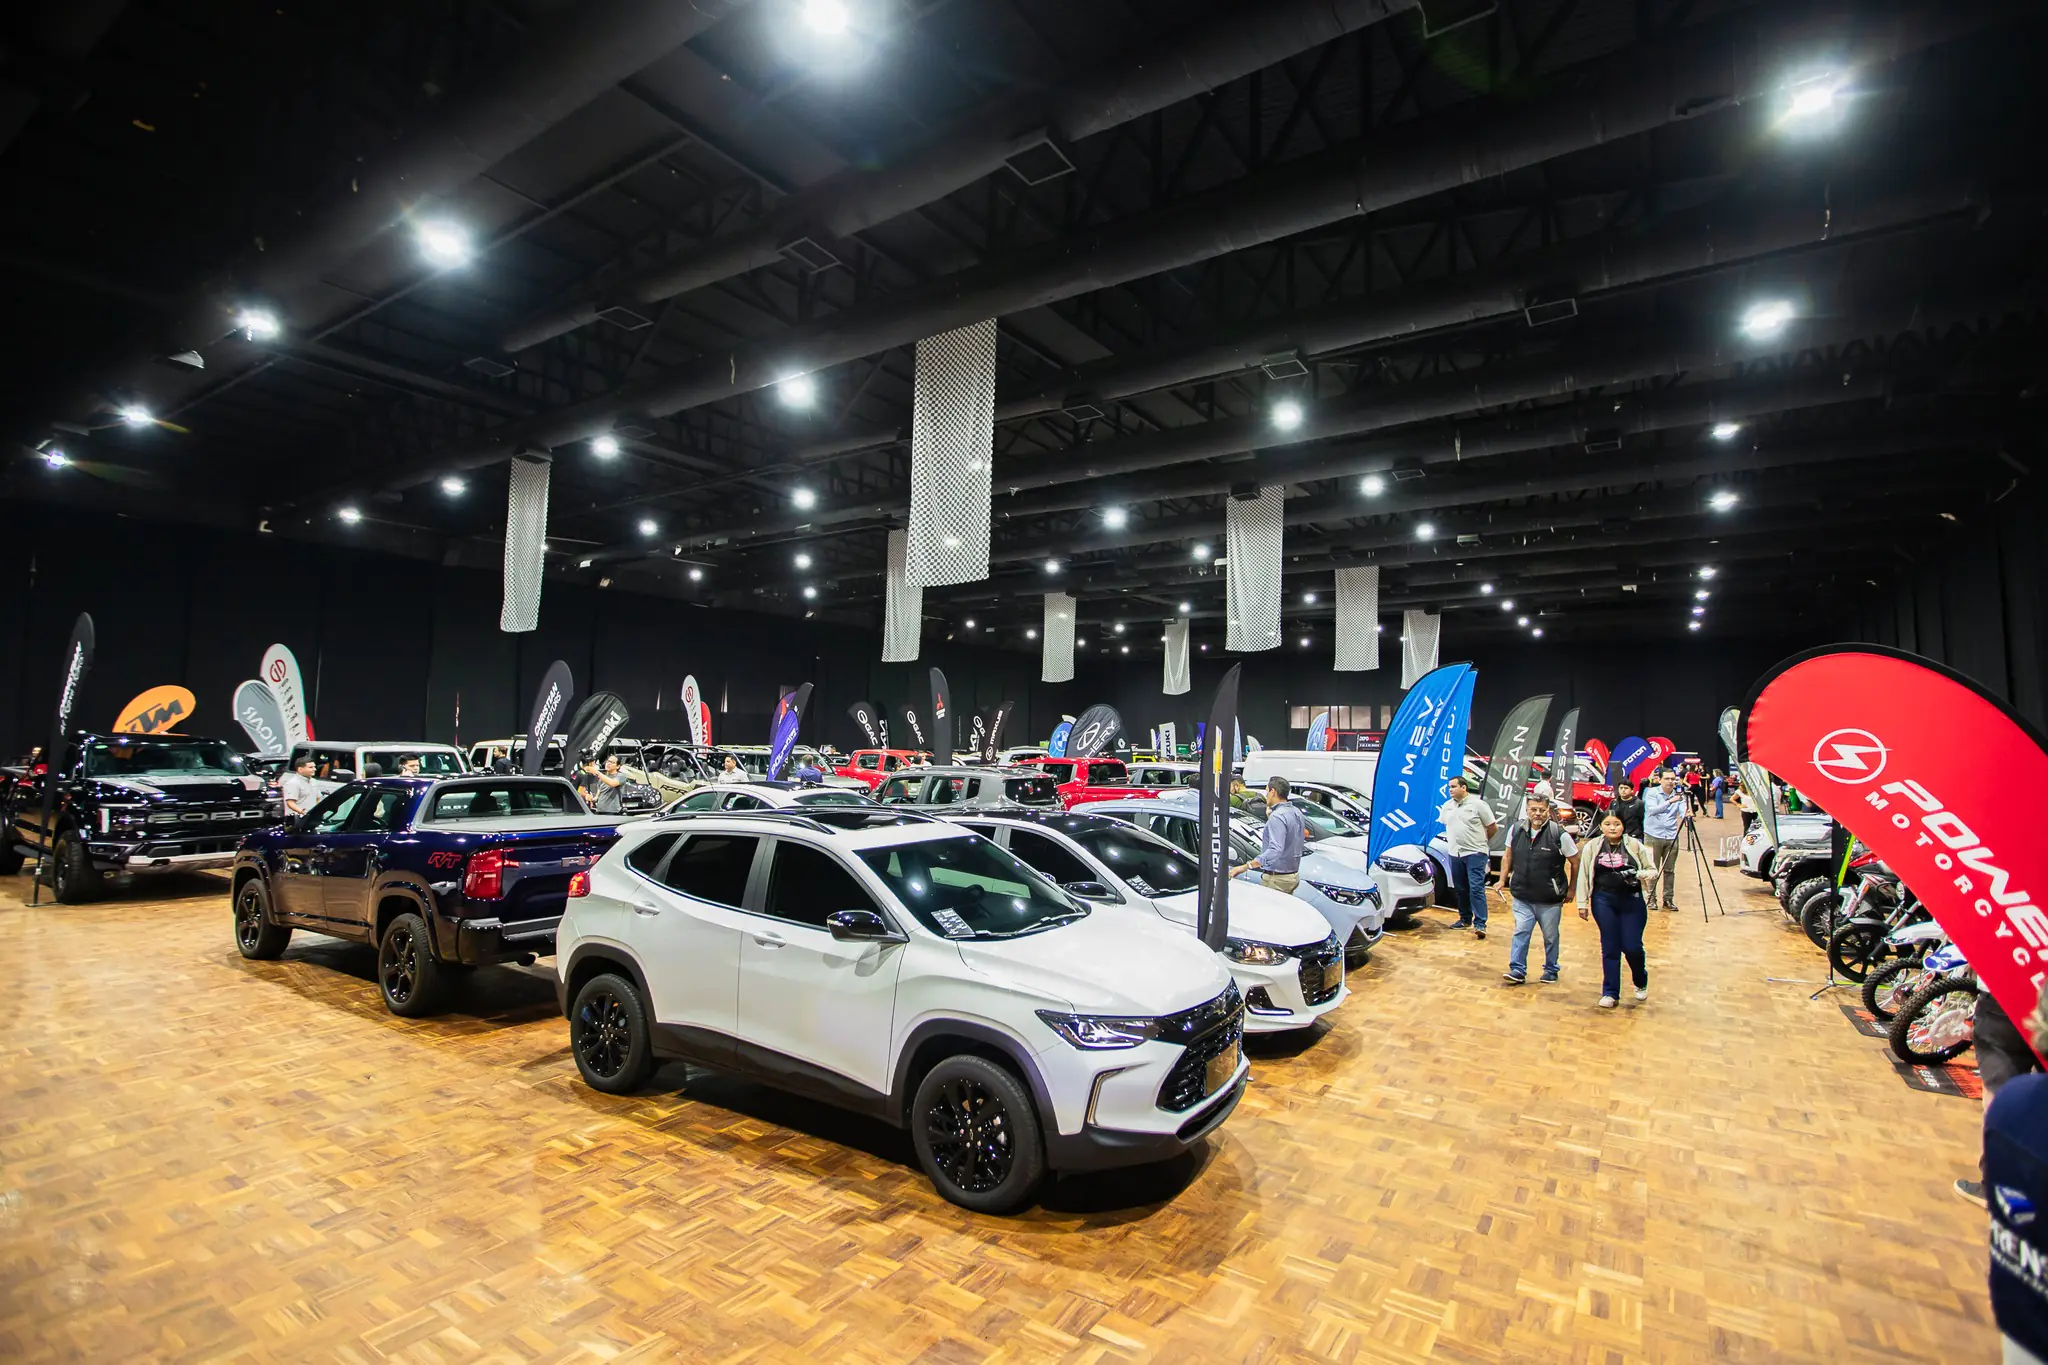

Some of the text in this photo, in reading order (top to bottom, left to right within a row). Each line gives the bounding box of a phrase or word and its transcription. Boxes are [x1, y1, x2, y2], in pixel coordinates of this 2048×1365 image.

[534, 681, 558, 737] CHRISTIAN
[864, 723, 878, 746] GAC
[912, 723, 925, 745] GAC
[1083, 719, 1117, 758] HERY
[1398, 695, 1435, 804] JMEV
[1622, 745, 1647, 767] FOTON
[1495, 725, 1530, 829] NISSAN
[1554, 728, 1572, 801] NISSAN
[147, 809, 264, 823] FORD
[1864, 790, 2047, 991] MOTORCYCL
